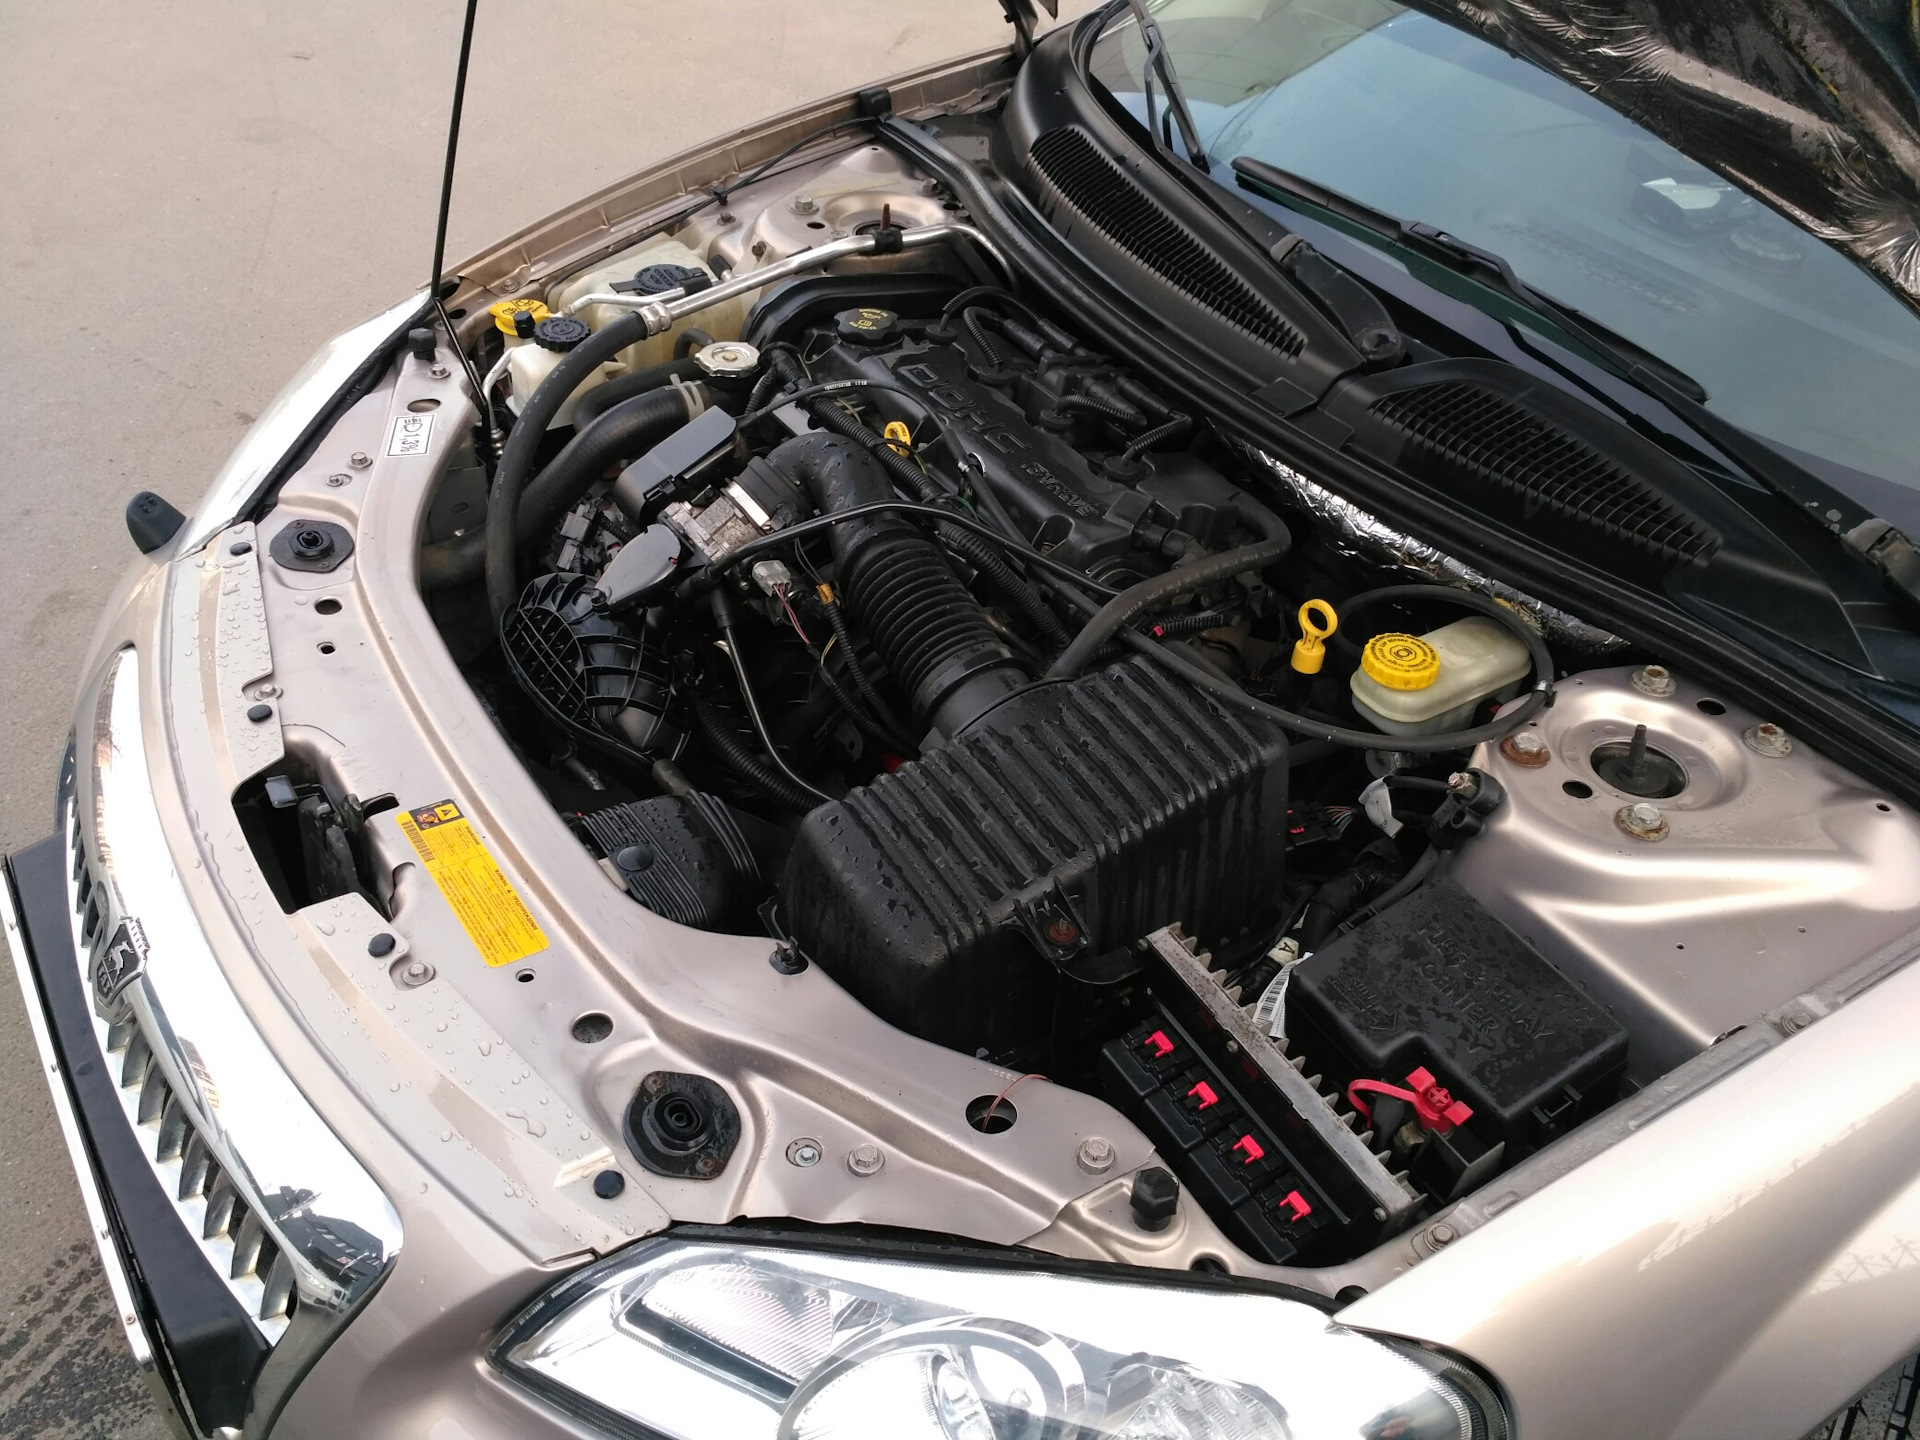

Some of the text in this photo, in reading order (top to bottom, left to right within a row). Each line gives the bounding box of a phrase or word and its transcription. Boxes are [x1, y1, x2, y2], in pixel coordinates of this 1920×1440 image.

[897, 363, 1032, 454] DOHC
[1419, 964, 1500, 1036] CENTER
[1486, 983, 1556, 1041] RELAY
